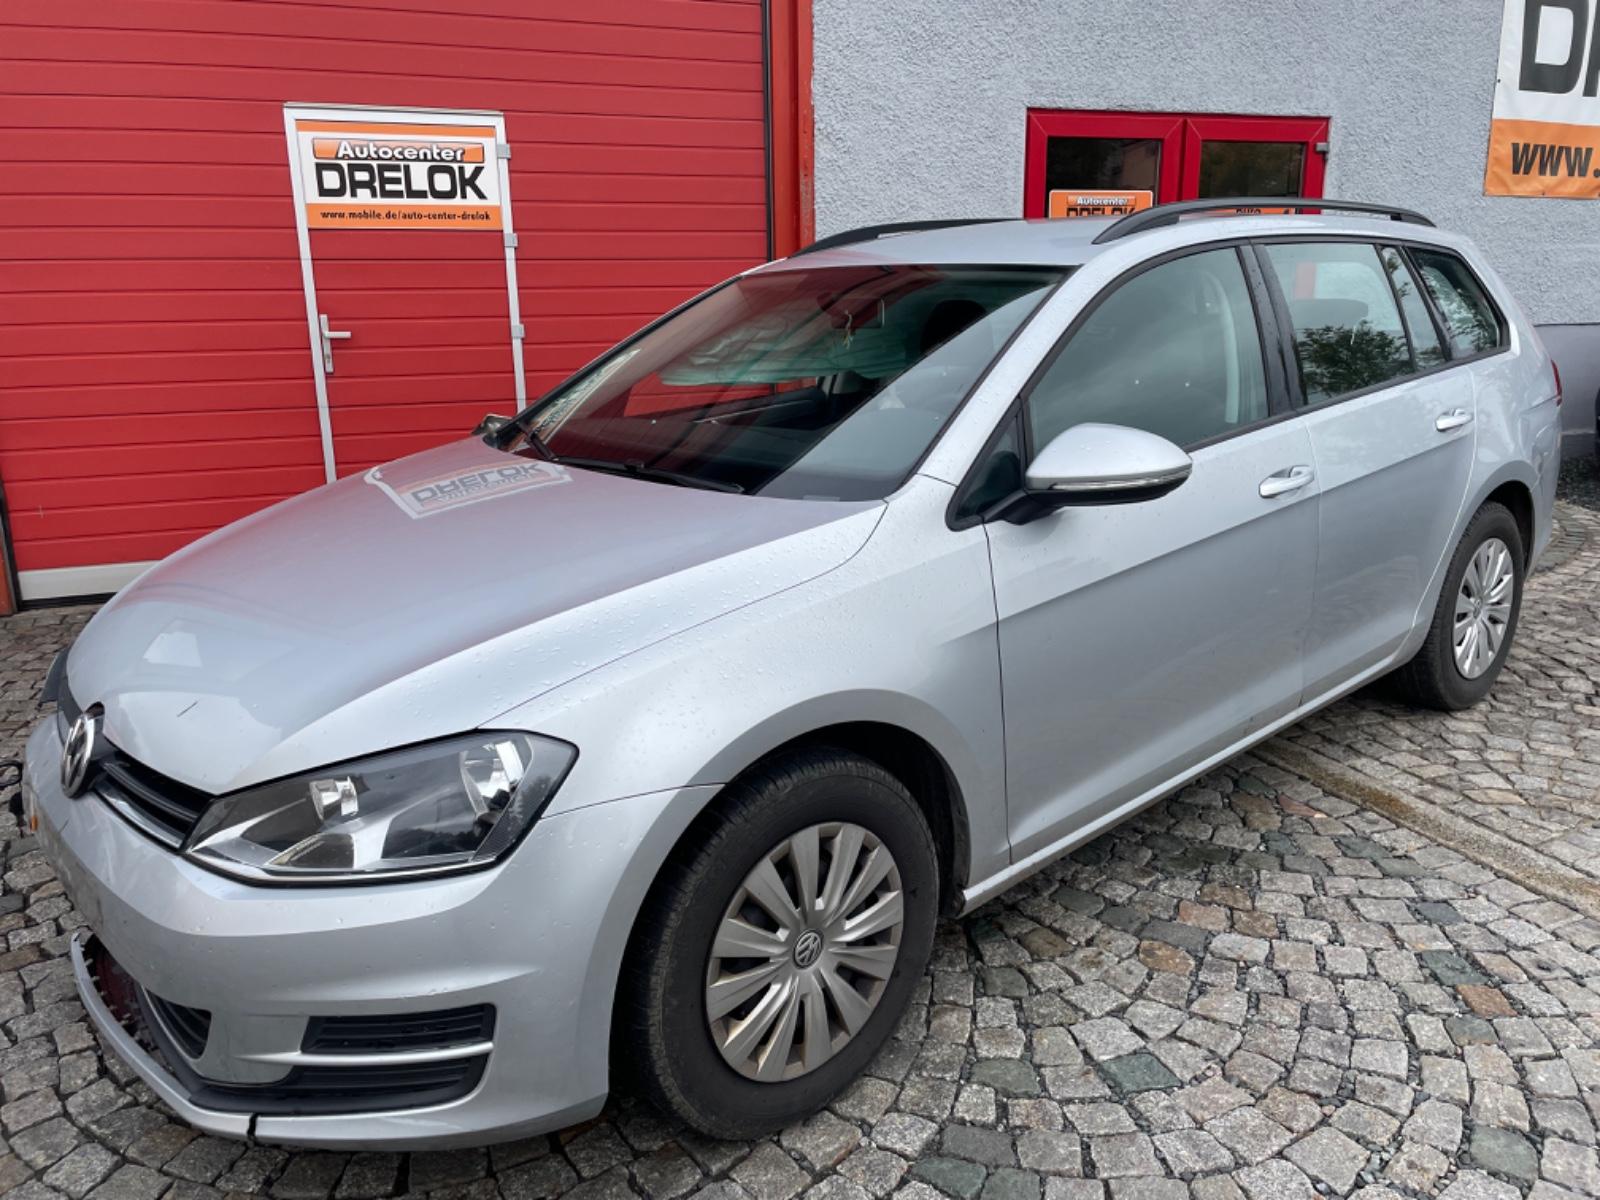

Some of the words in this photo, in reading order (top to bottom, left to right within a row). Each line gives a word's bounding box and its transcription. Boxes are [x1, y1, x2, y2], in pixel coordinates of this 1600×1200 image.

[1519, 0, 1600, 97] D
[337, 140, 466, 161] Autocenter
[315, 162, 488, 200] DRELOK
[320, 209, 491, 221] www.mobile.de/auto-center-drelok
